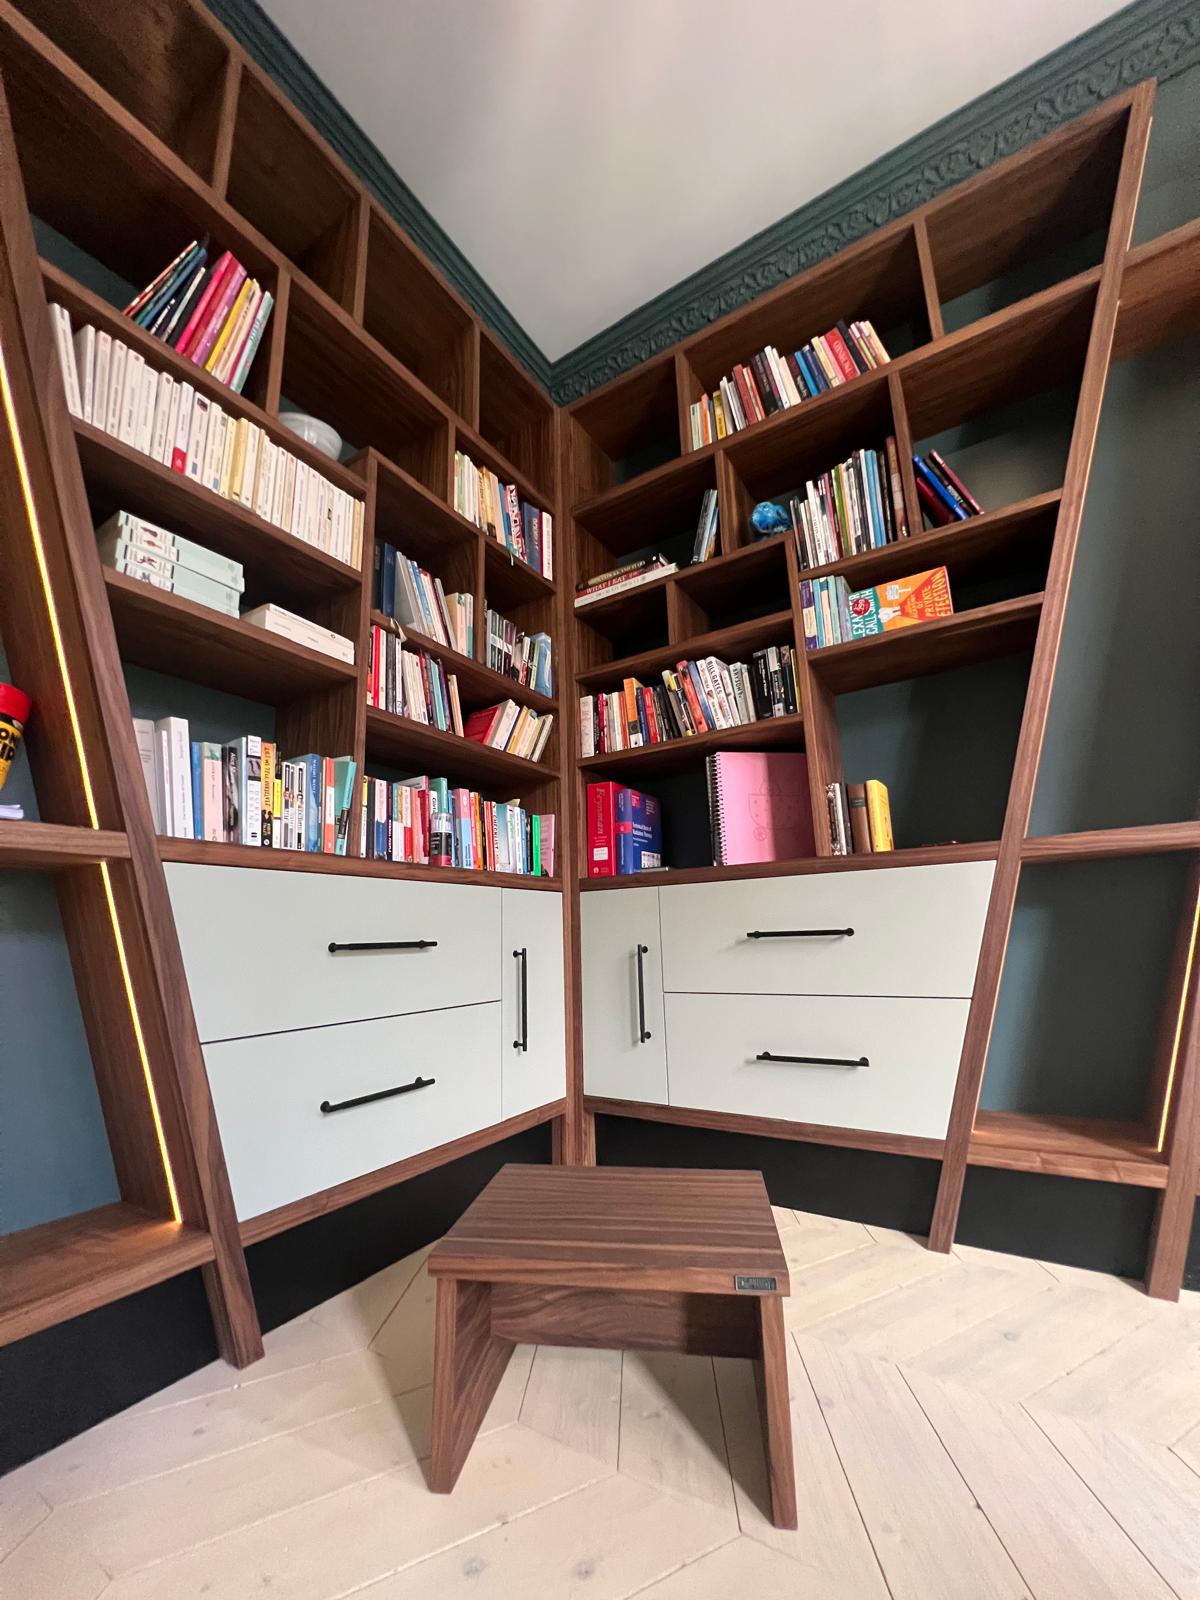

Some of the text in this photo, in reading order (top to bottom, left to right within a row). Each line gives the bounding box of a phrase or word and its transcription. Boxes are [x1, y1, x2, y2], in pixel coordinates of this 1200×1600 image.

[586, 583, 607, 594] WHAT
[611, 575, 627, 584] EAT
[931, 570, 951, 617] ETECTION
[922, 586, 934, 617] PRIVATE
[706, 660, 723, 695] BILL GATES
